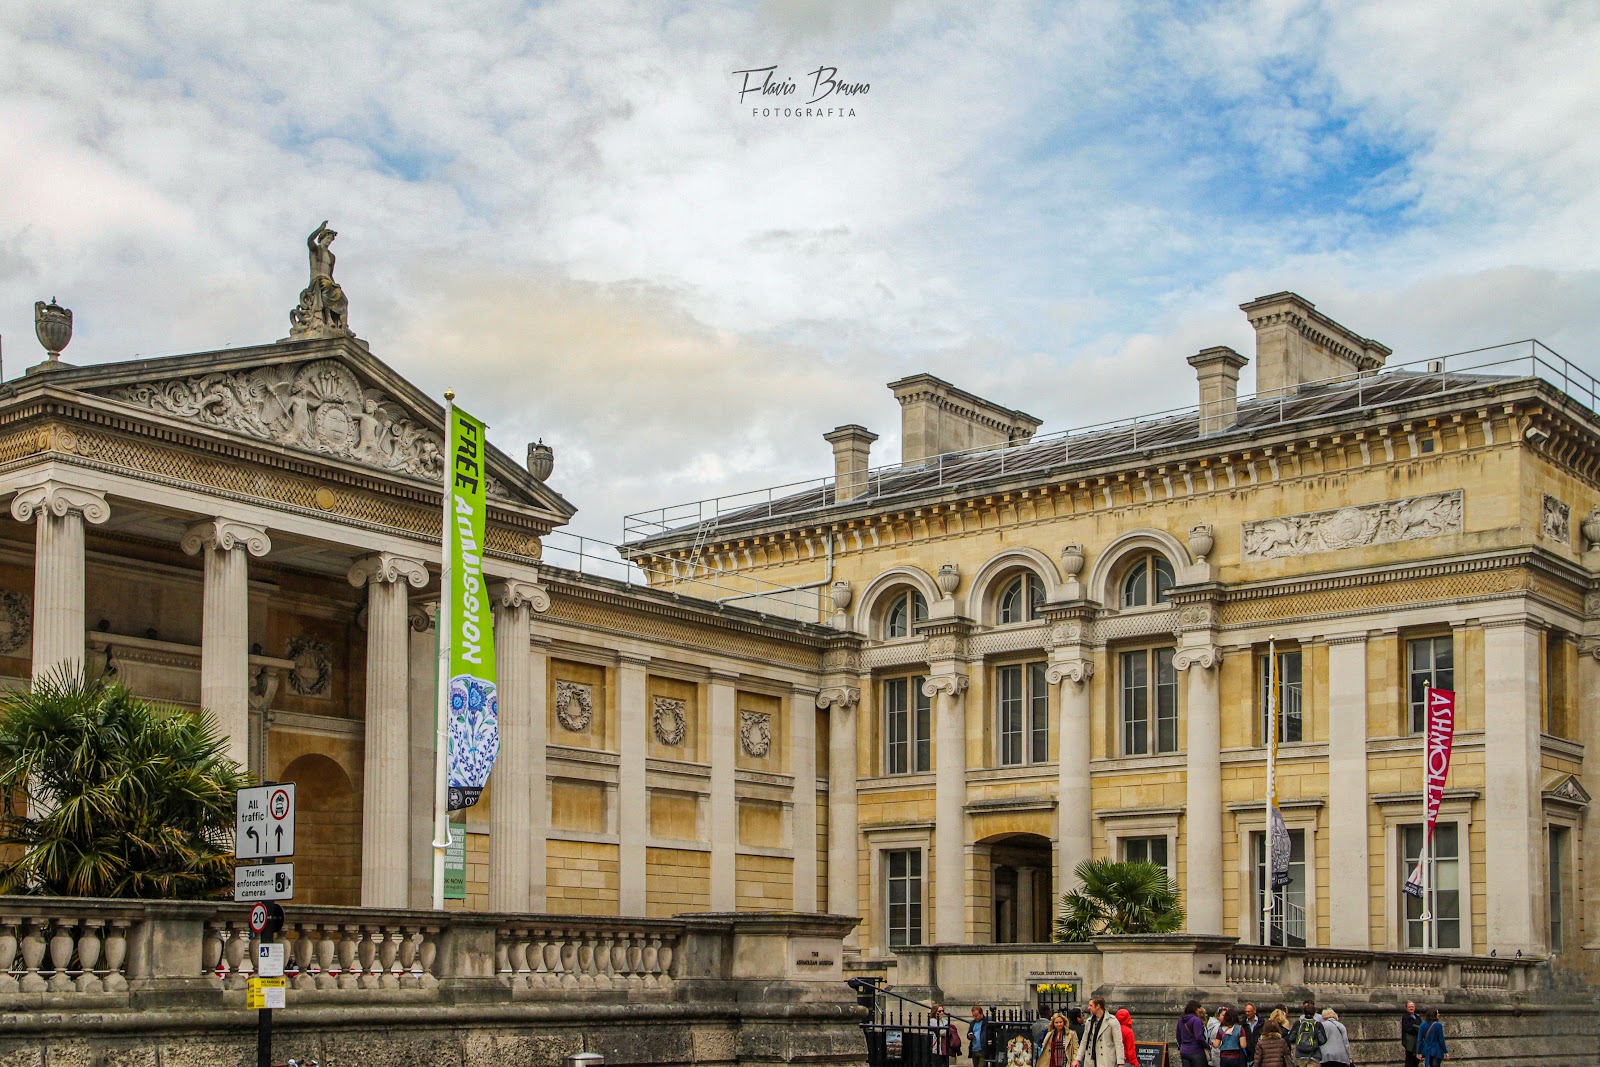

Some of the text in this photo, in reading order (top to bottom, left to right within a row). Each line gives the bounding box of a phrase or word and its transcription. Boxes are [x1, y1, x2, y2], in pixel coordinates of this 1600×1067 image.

[454, 418, 482, 664] FREE ADMISSION
[1427, 692, 1452, 822] ASHMOLEAN
[248, 800, 259, 810] All
[241, 812, 265, 823] traffic
[453, 863, 464, 871] MORE
[246, 869, 265, 878] Traffic
[237, 879, 274, 888] enforcement
[241, 889, 266, 897] cameras
[253, 911, 265, 924] 20
